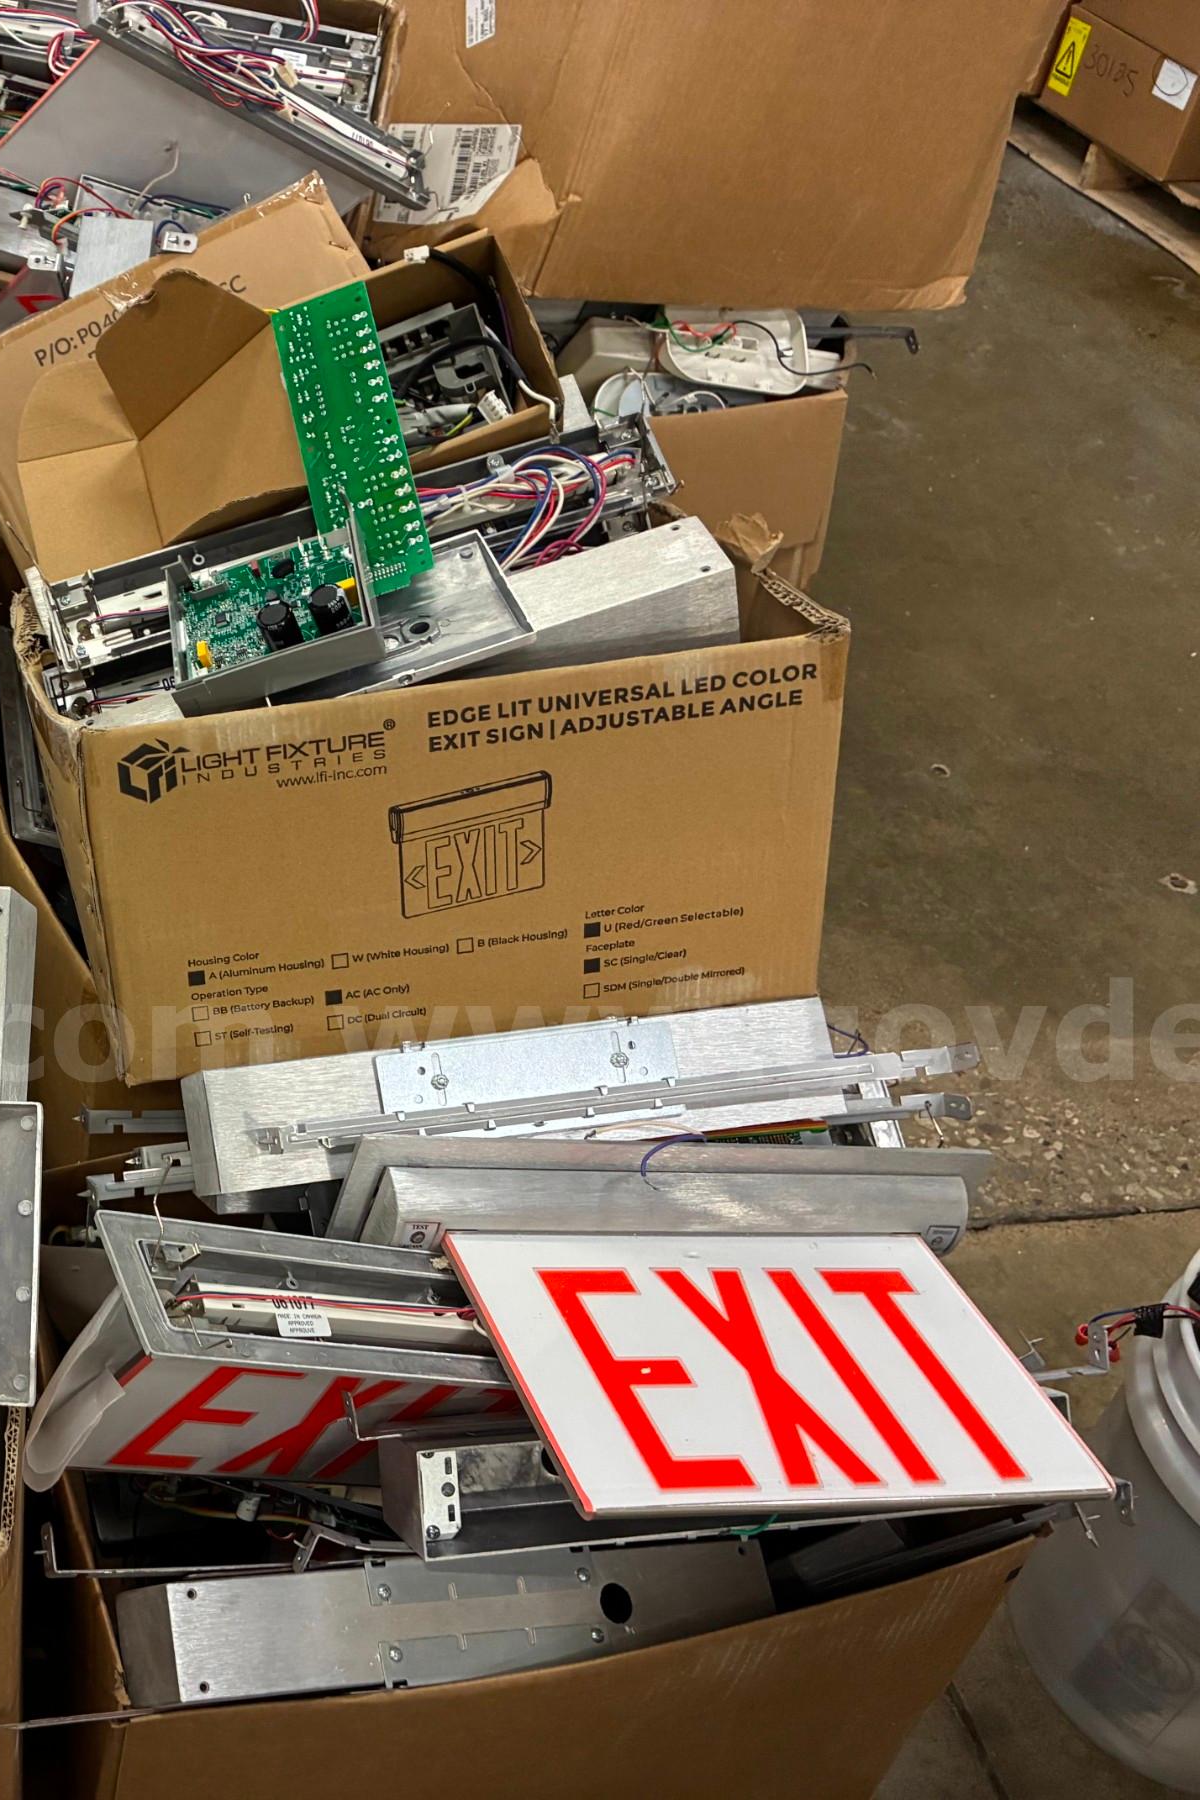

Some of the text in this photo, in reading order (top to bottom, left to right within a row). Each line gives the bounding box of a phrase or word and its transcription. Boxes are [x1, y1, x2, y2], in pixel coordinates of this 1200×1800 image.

[427, 663, 818, 728] EDGE LIT UNIVERSAL LED COLOR
[429, 730, 480, 753] EXIT
[486, 722, 544, 744] SIGN
[560, 700, 715, 736] ADJUSTABLE
[719, 689, 803, 715] ANGLE
[181, 748, 260, 772] LIGHT
[182, 749, 386, 786] INDUSTRIES
[277, 764, 387, 788] www.lfi-inc.com
[425, 817, 524, 909] EXIT
[585, 904, 644, 920] Letter Color
[615, 915, 678, 932] (Red/Green
[680, 907, 744, 923] Selectable)
[477, 928, 568, 948] B (Black Housing)
[585, 939, 635, 952] Faceplate
[187, 951, 259, 969] Housing Color
[352, 943, 450, 963] W (White Housing)
[604, 949, 687, 967] SC (Single/Clear)
[208, 958, 325, 980] A (Aluminum Housing)
[604, 967, 745, 992] SDM (Single/Double Mirrored)
[191, 985, 268, 1003] Operation Type
[345, 984, 410, 1000] AC (AC Only)
[212, 994, 314, 1016] BB (Battery Backup)
[348, 1007, 427, 1025] DC (Dual Circuit)
[214, 1023, 294, 1041] ST (Self-Testing)
[534, 1267, 1032, 1491] EXIT
